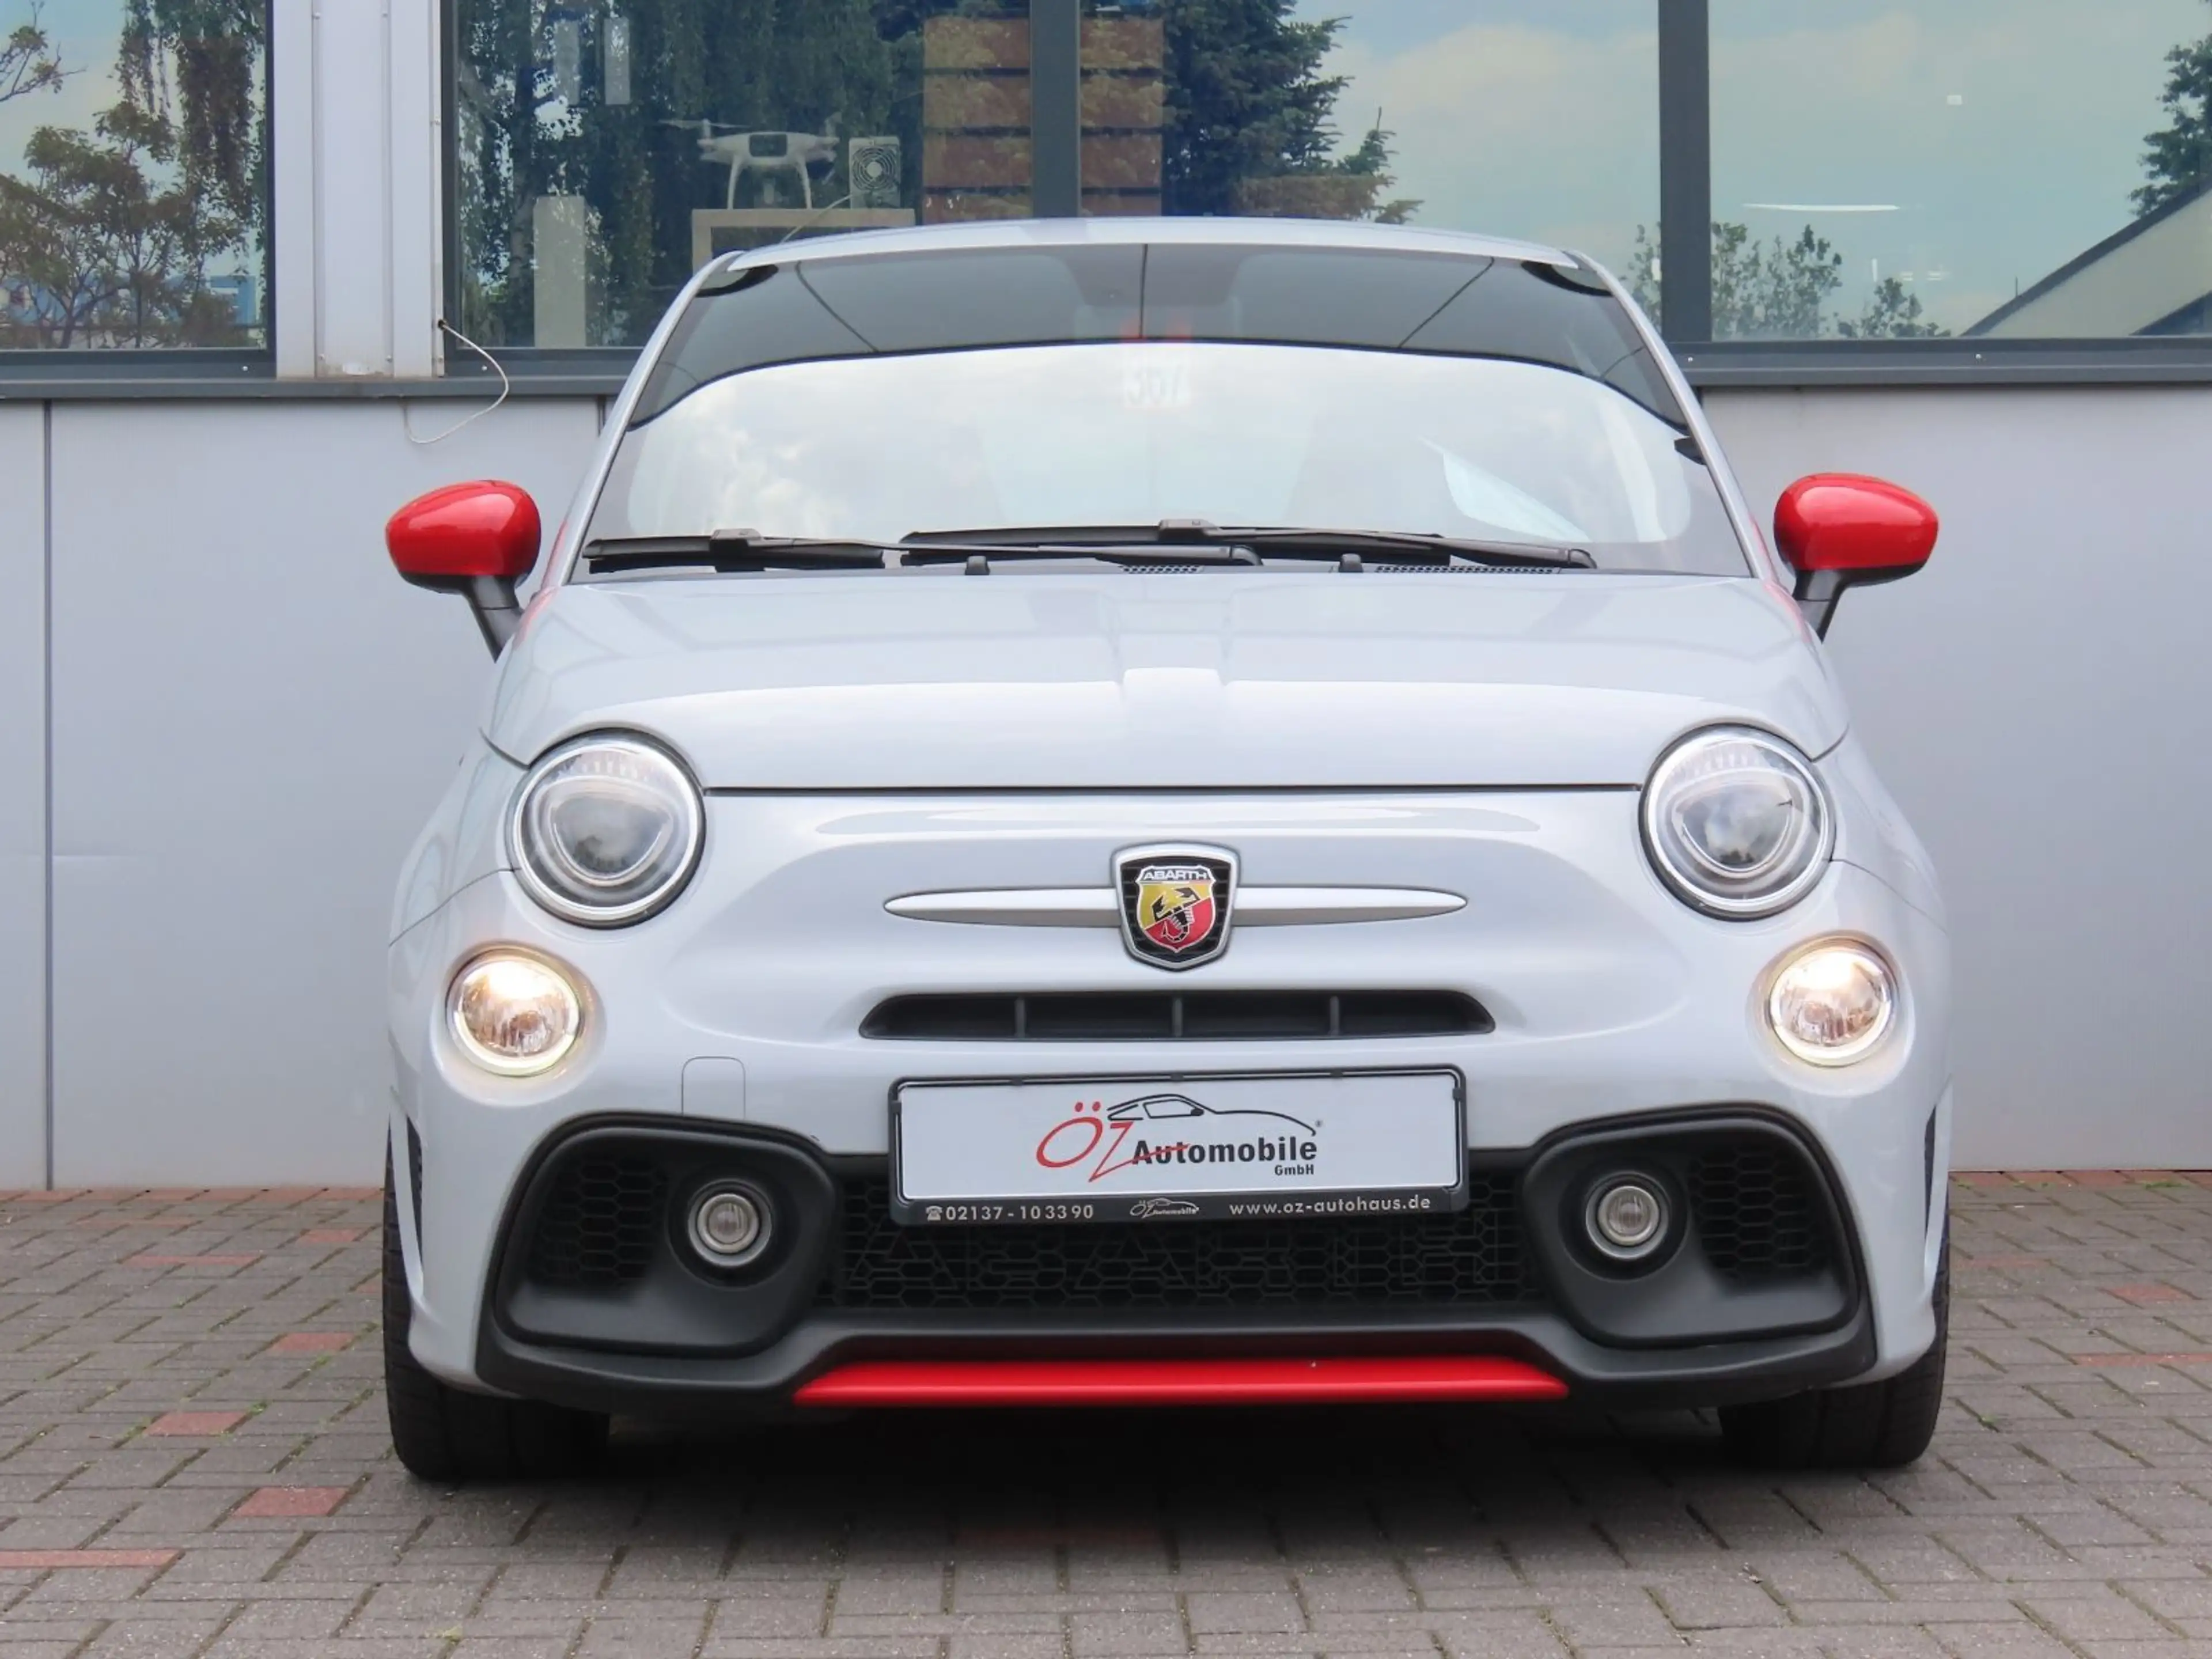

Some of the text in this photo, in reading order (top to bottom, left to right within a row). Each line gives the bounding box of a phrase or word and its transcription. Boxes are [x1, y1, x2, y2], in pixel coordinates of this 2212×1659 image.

[1143, 870, 1207, 880] ABARTH
[1132, 1136, 1317, 1165] Automobile
[1274, 1164, 1315, 1176] GmbH
[1229, 1194, 1431, 1215] www.oz-autohaus.de
